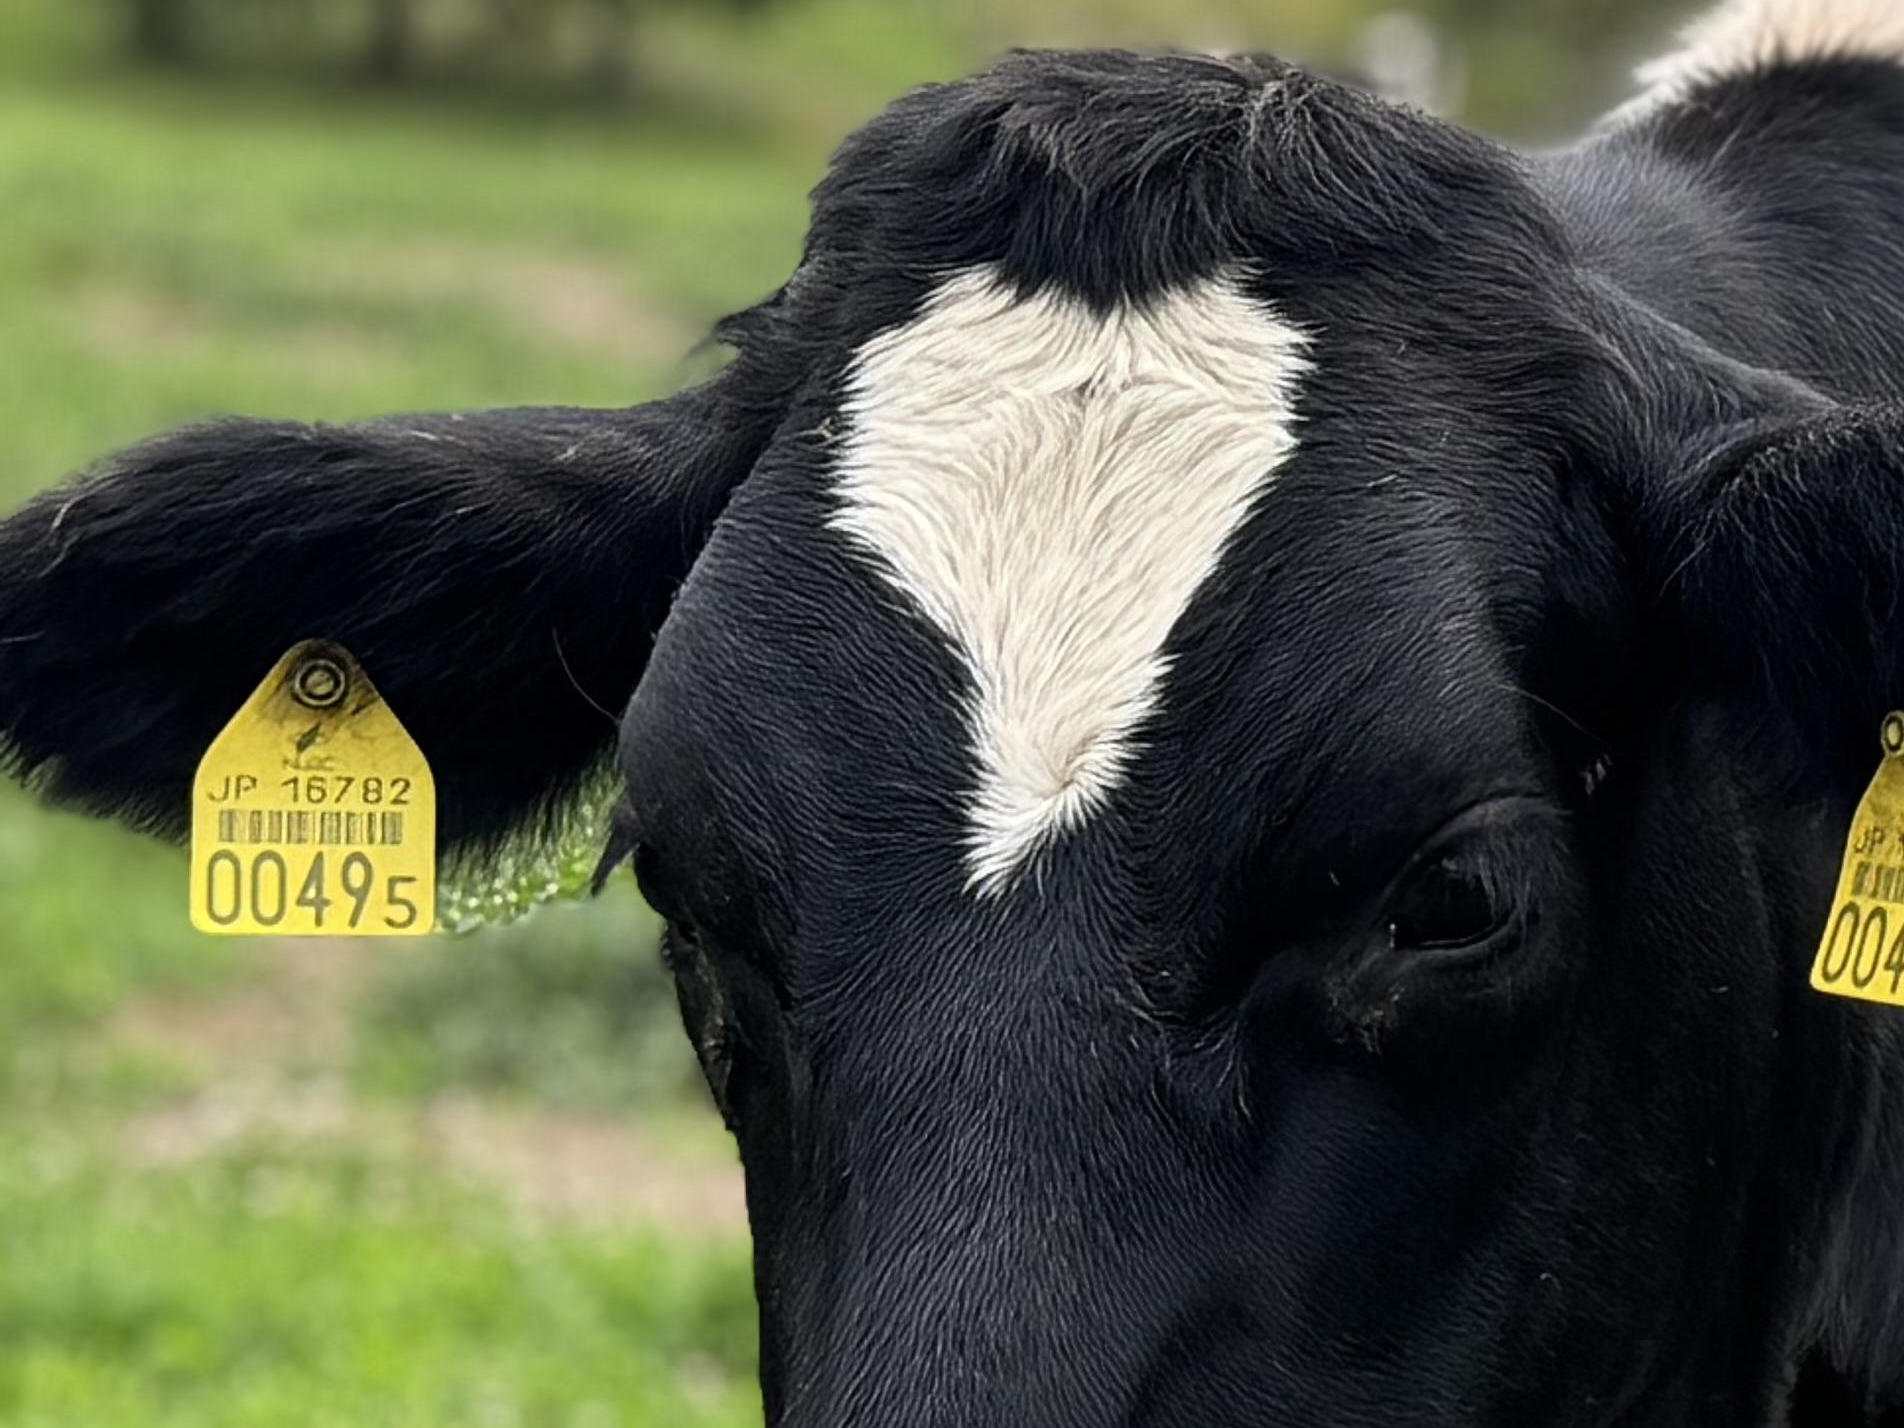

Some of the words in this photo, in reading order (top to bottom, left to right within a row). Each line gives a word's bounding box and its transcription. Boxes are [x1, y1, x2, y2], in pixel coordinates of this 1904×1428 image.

[208, 775, 257, 802] JP
[281, 777, 411, 805] 16782
[1853, 826, 1884, 855] JP
[207, 849, 418, 929] 00495
